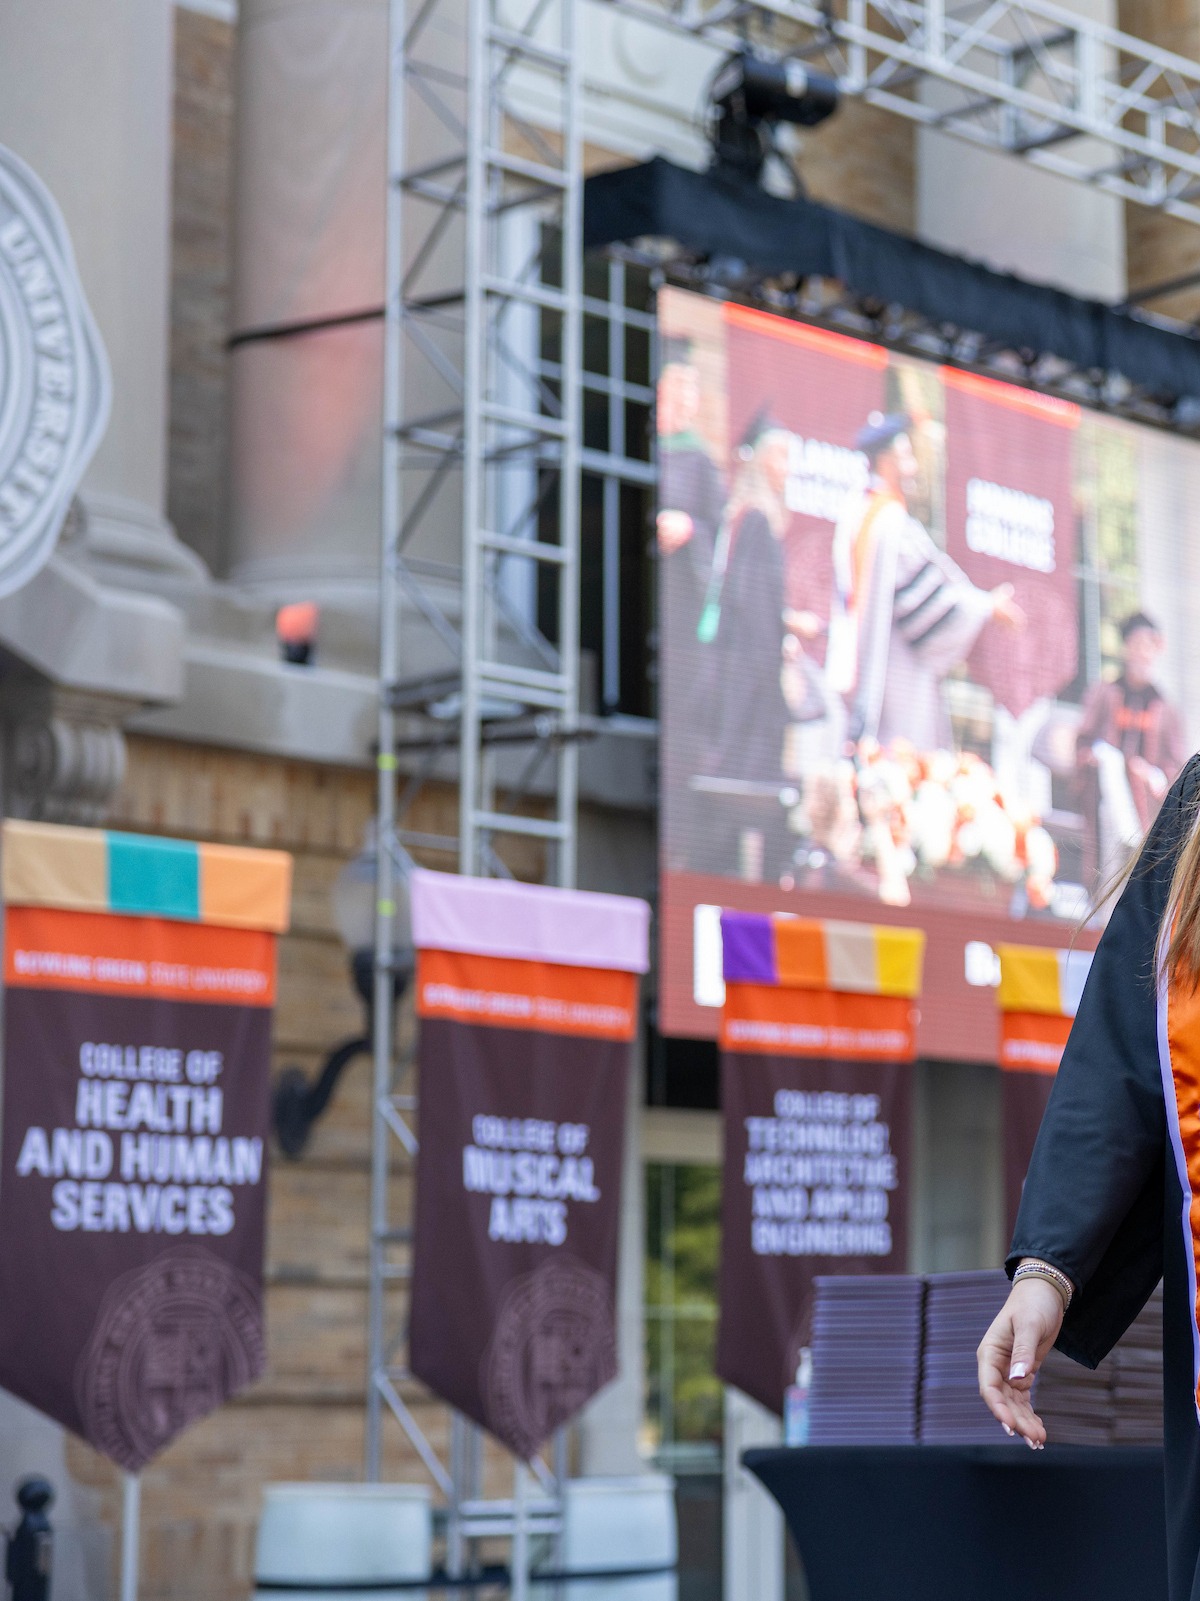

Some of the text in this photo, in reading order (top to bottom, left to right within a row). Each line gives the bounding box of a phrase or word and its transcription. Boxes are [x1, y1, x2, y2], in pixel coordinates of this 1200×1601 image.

[0, 220, 72, 535] UNIVERSIT
[79, 1041, 224, 1085] COLLEGE OF
[75, 1077, 223, 1135] HEALTH
[15, 1126, 264, 1186] AND HUMAN
[488, 1196, 568, 1247] ARTS
